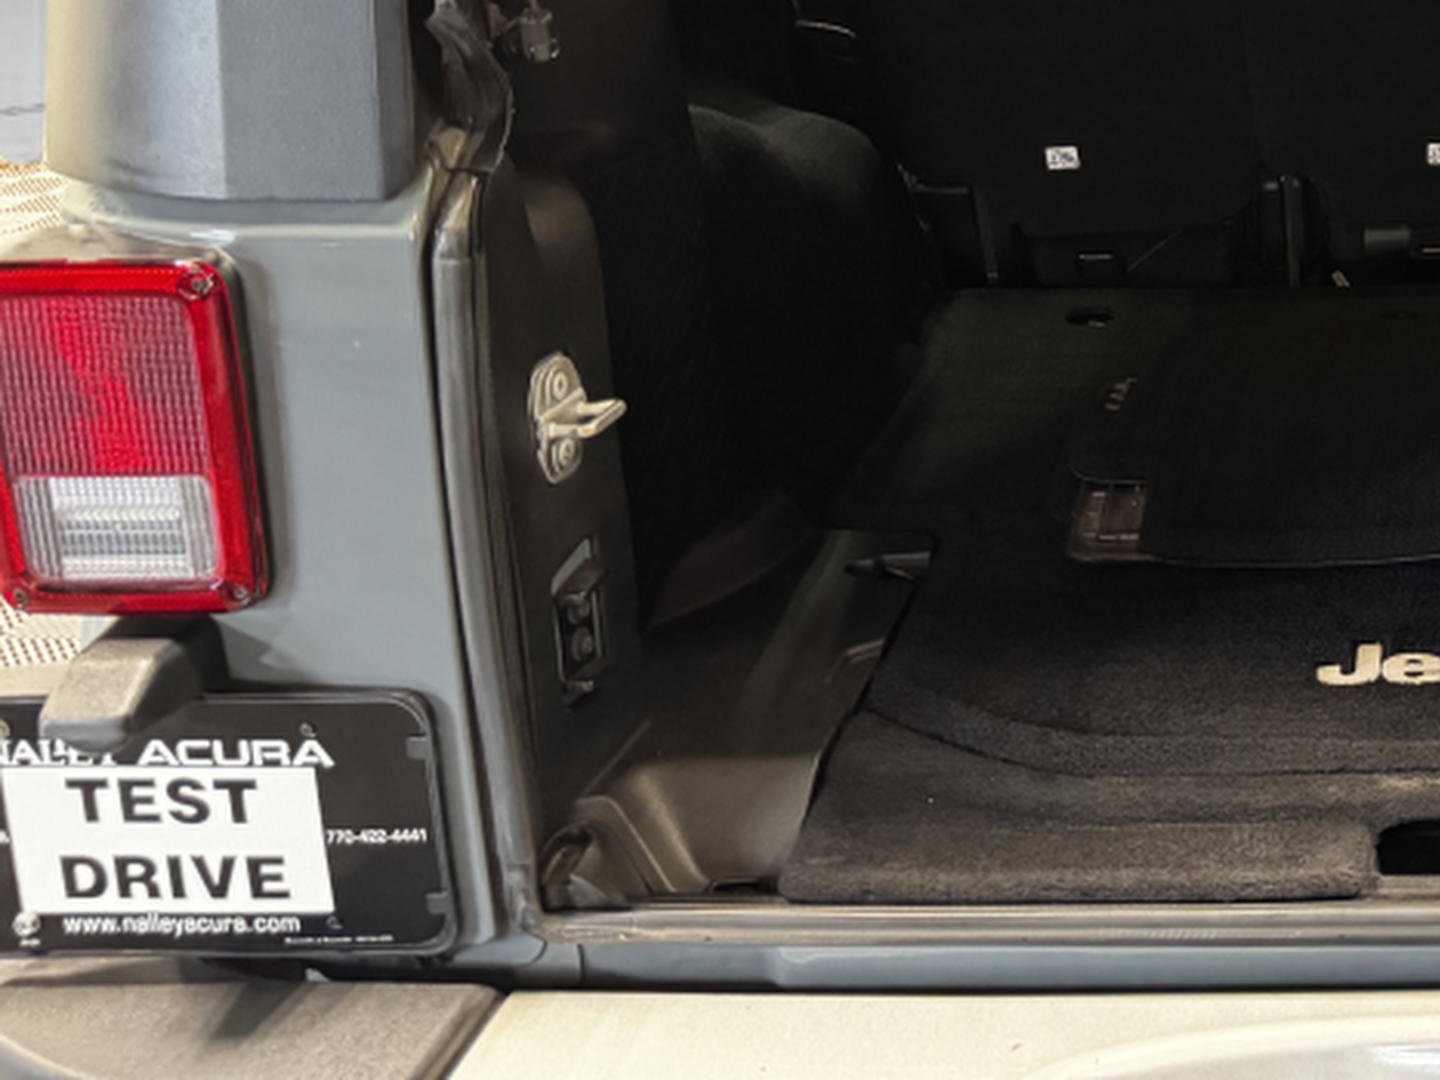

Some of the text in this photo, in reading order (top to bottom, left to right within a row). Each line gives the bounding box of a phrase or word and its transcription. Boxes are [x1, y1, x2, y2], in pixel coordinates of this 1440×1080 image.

[138, 738, 335, 768] ACURA
[65, 778, 257, 824] TEST
[59, 855, 291, 900] DRIVE
[62, 911, 301, 938] www.nalleyacura.com
